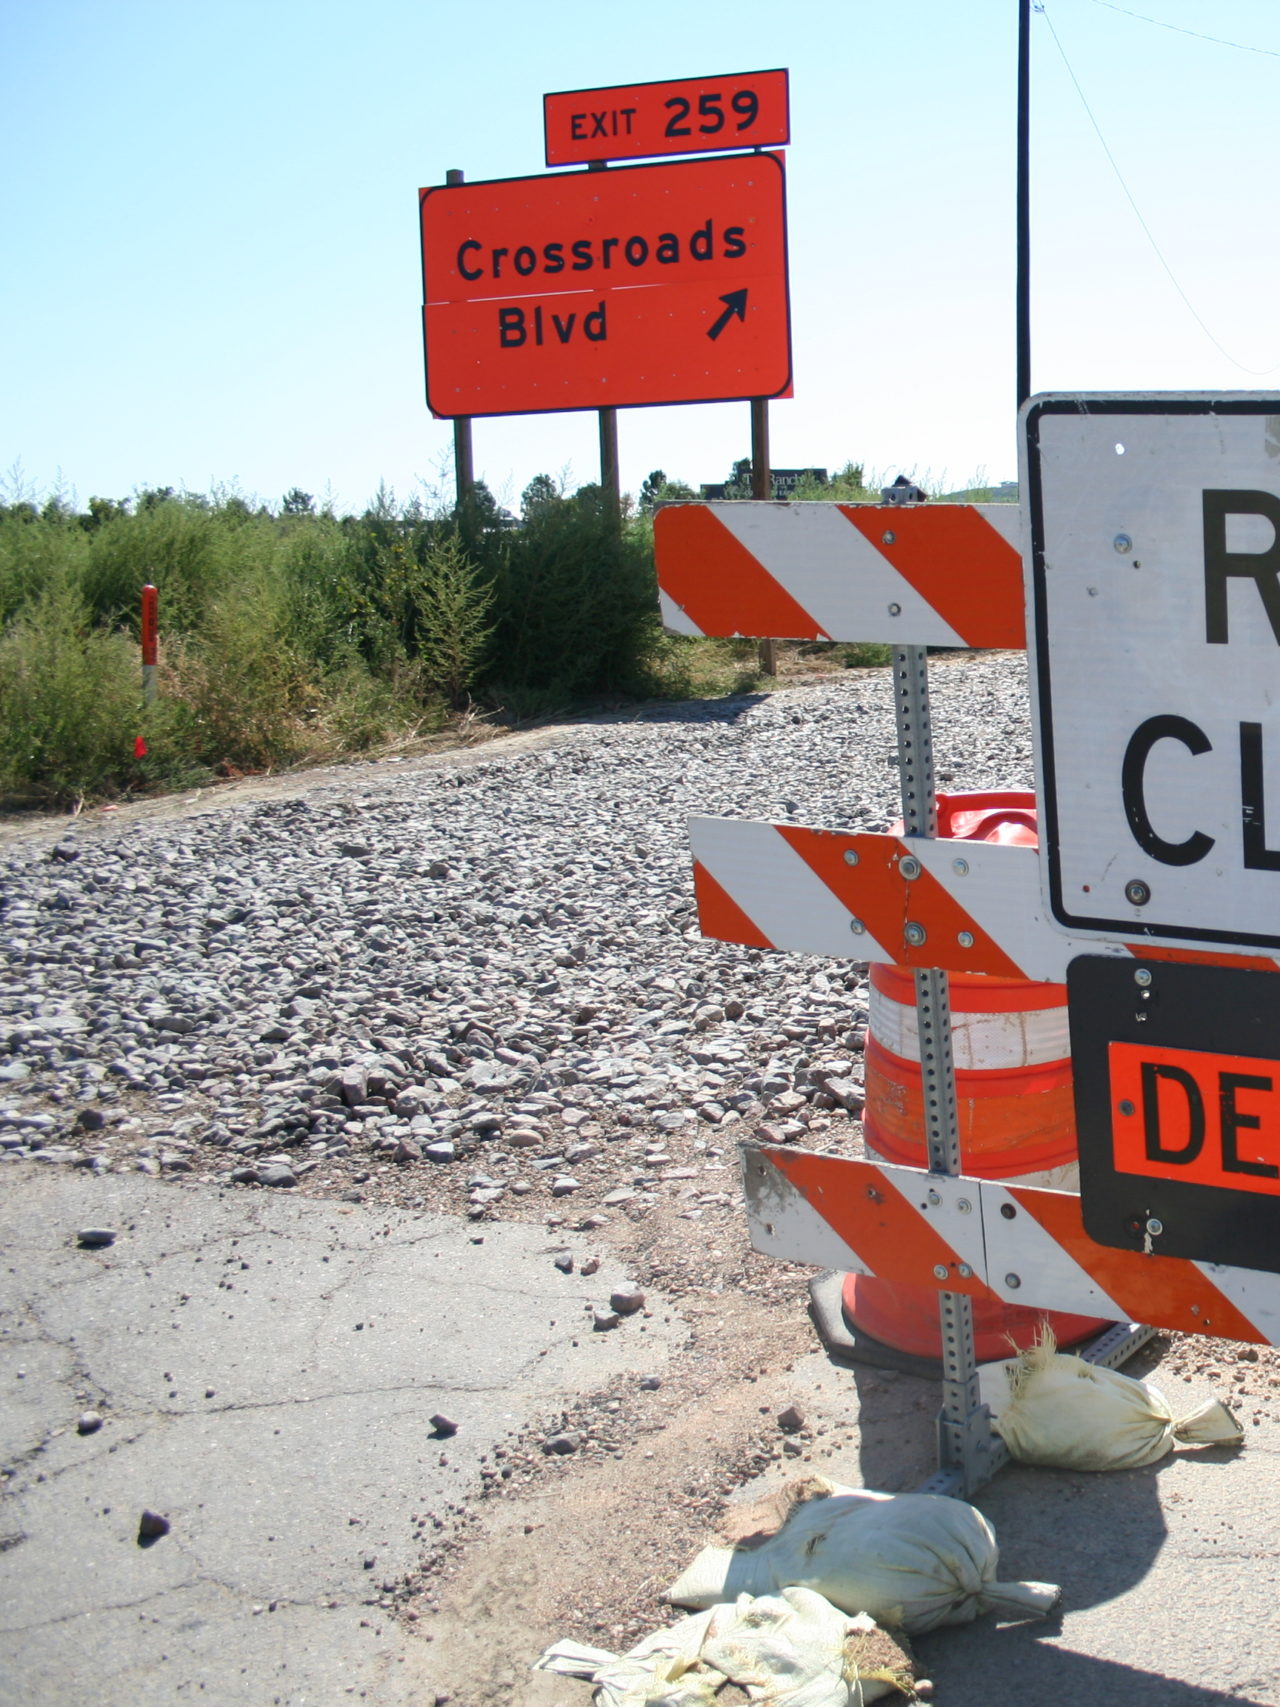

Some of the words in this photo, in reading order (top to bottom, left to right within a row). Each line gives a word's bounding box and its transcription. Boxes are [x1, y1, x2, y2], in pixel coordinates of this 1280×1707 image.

[570, 107, 637, 140] EXIT
[664, 90, 759, 138] 259
[457, 218, 747, 281] Crossroads
[498, 301, 608, 349] Blvd
